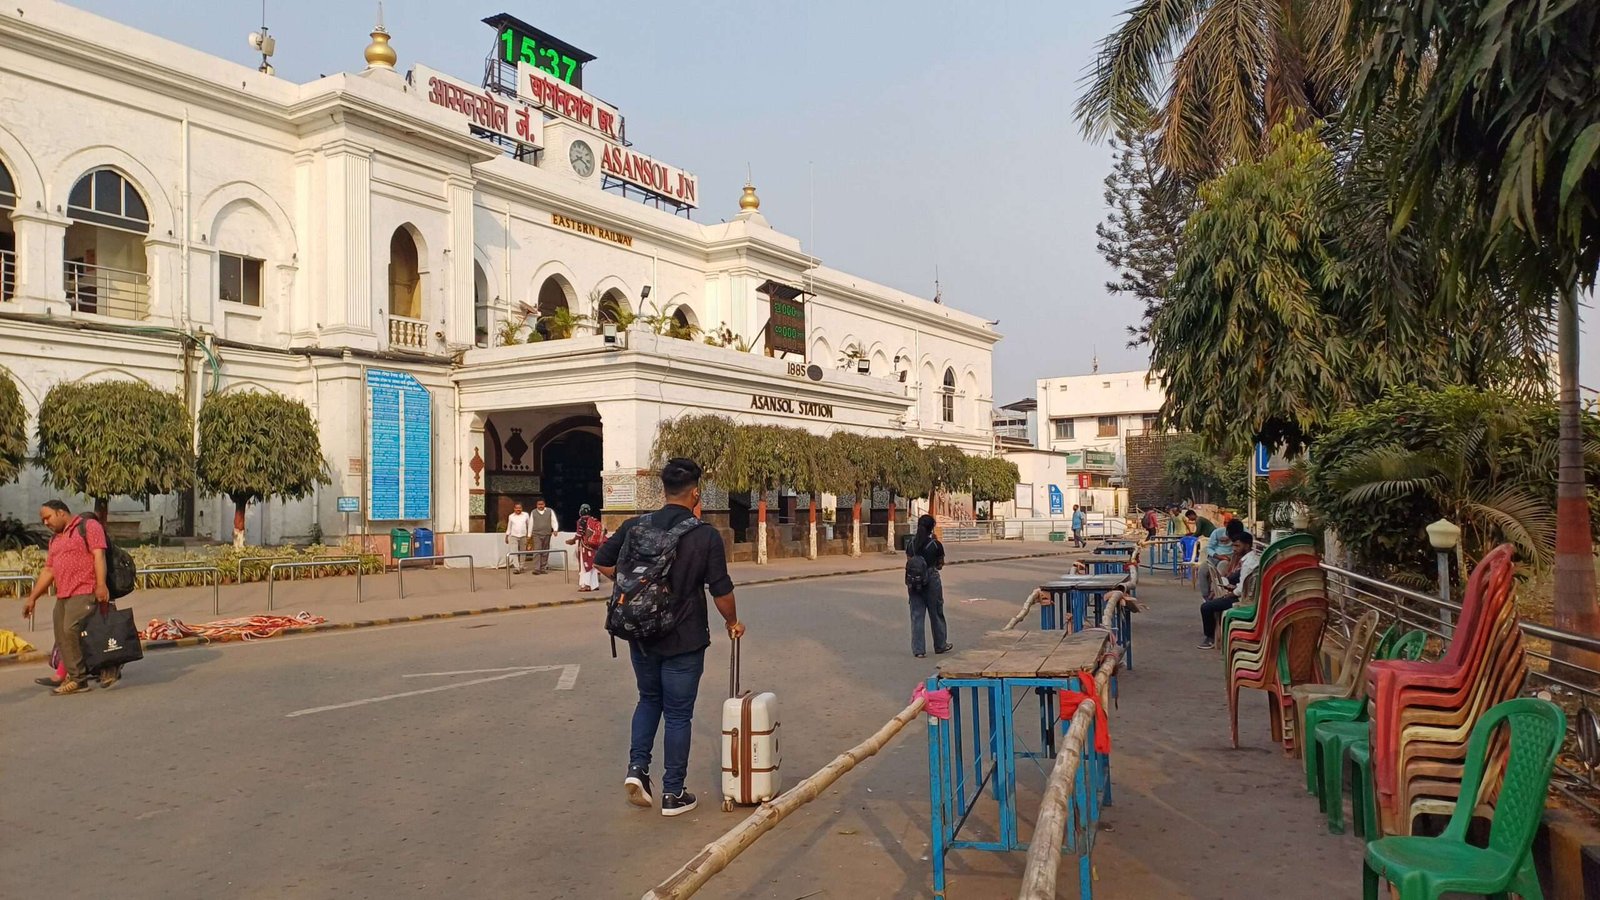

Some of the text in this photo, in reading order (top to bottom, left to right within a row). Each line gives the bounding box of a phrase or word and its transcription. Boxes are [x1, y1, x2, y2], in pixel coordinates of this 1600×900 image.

[501, 28, 577, 85] 15:37
[428, 76, 535, 143] आसनसोल जं.
[601, 143, 695, 201] ASANSOL JN
[553, 213, 633, 247] EASTERN RAILWAY
[787, 362, 806, 377] 1885
[751, 394, 833, 419] ASANSOL STATION
